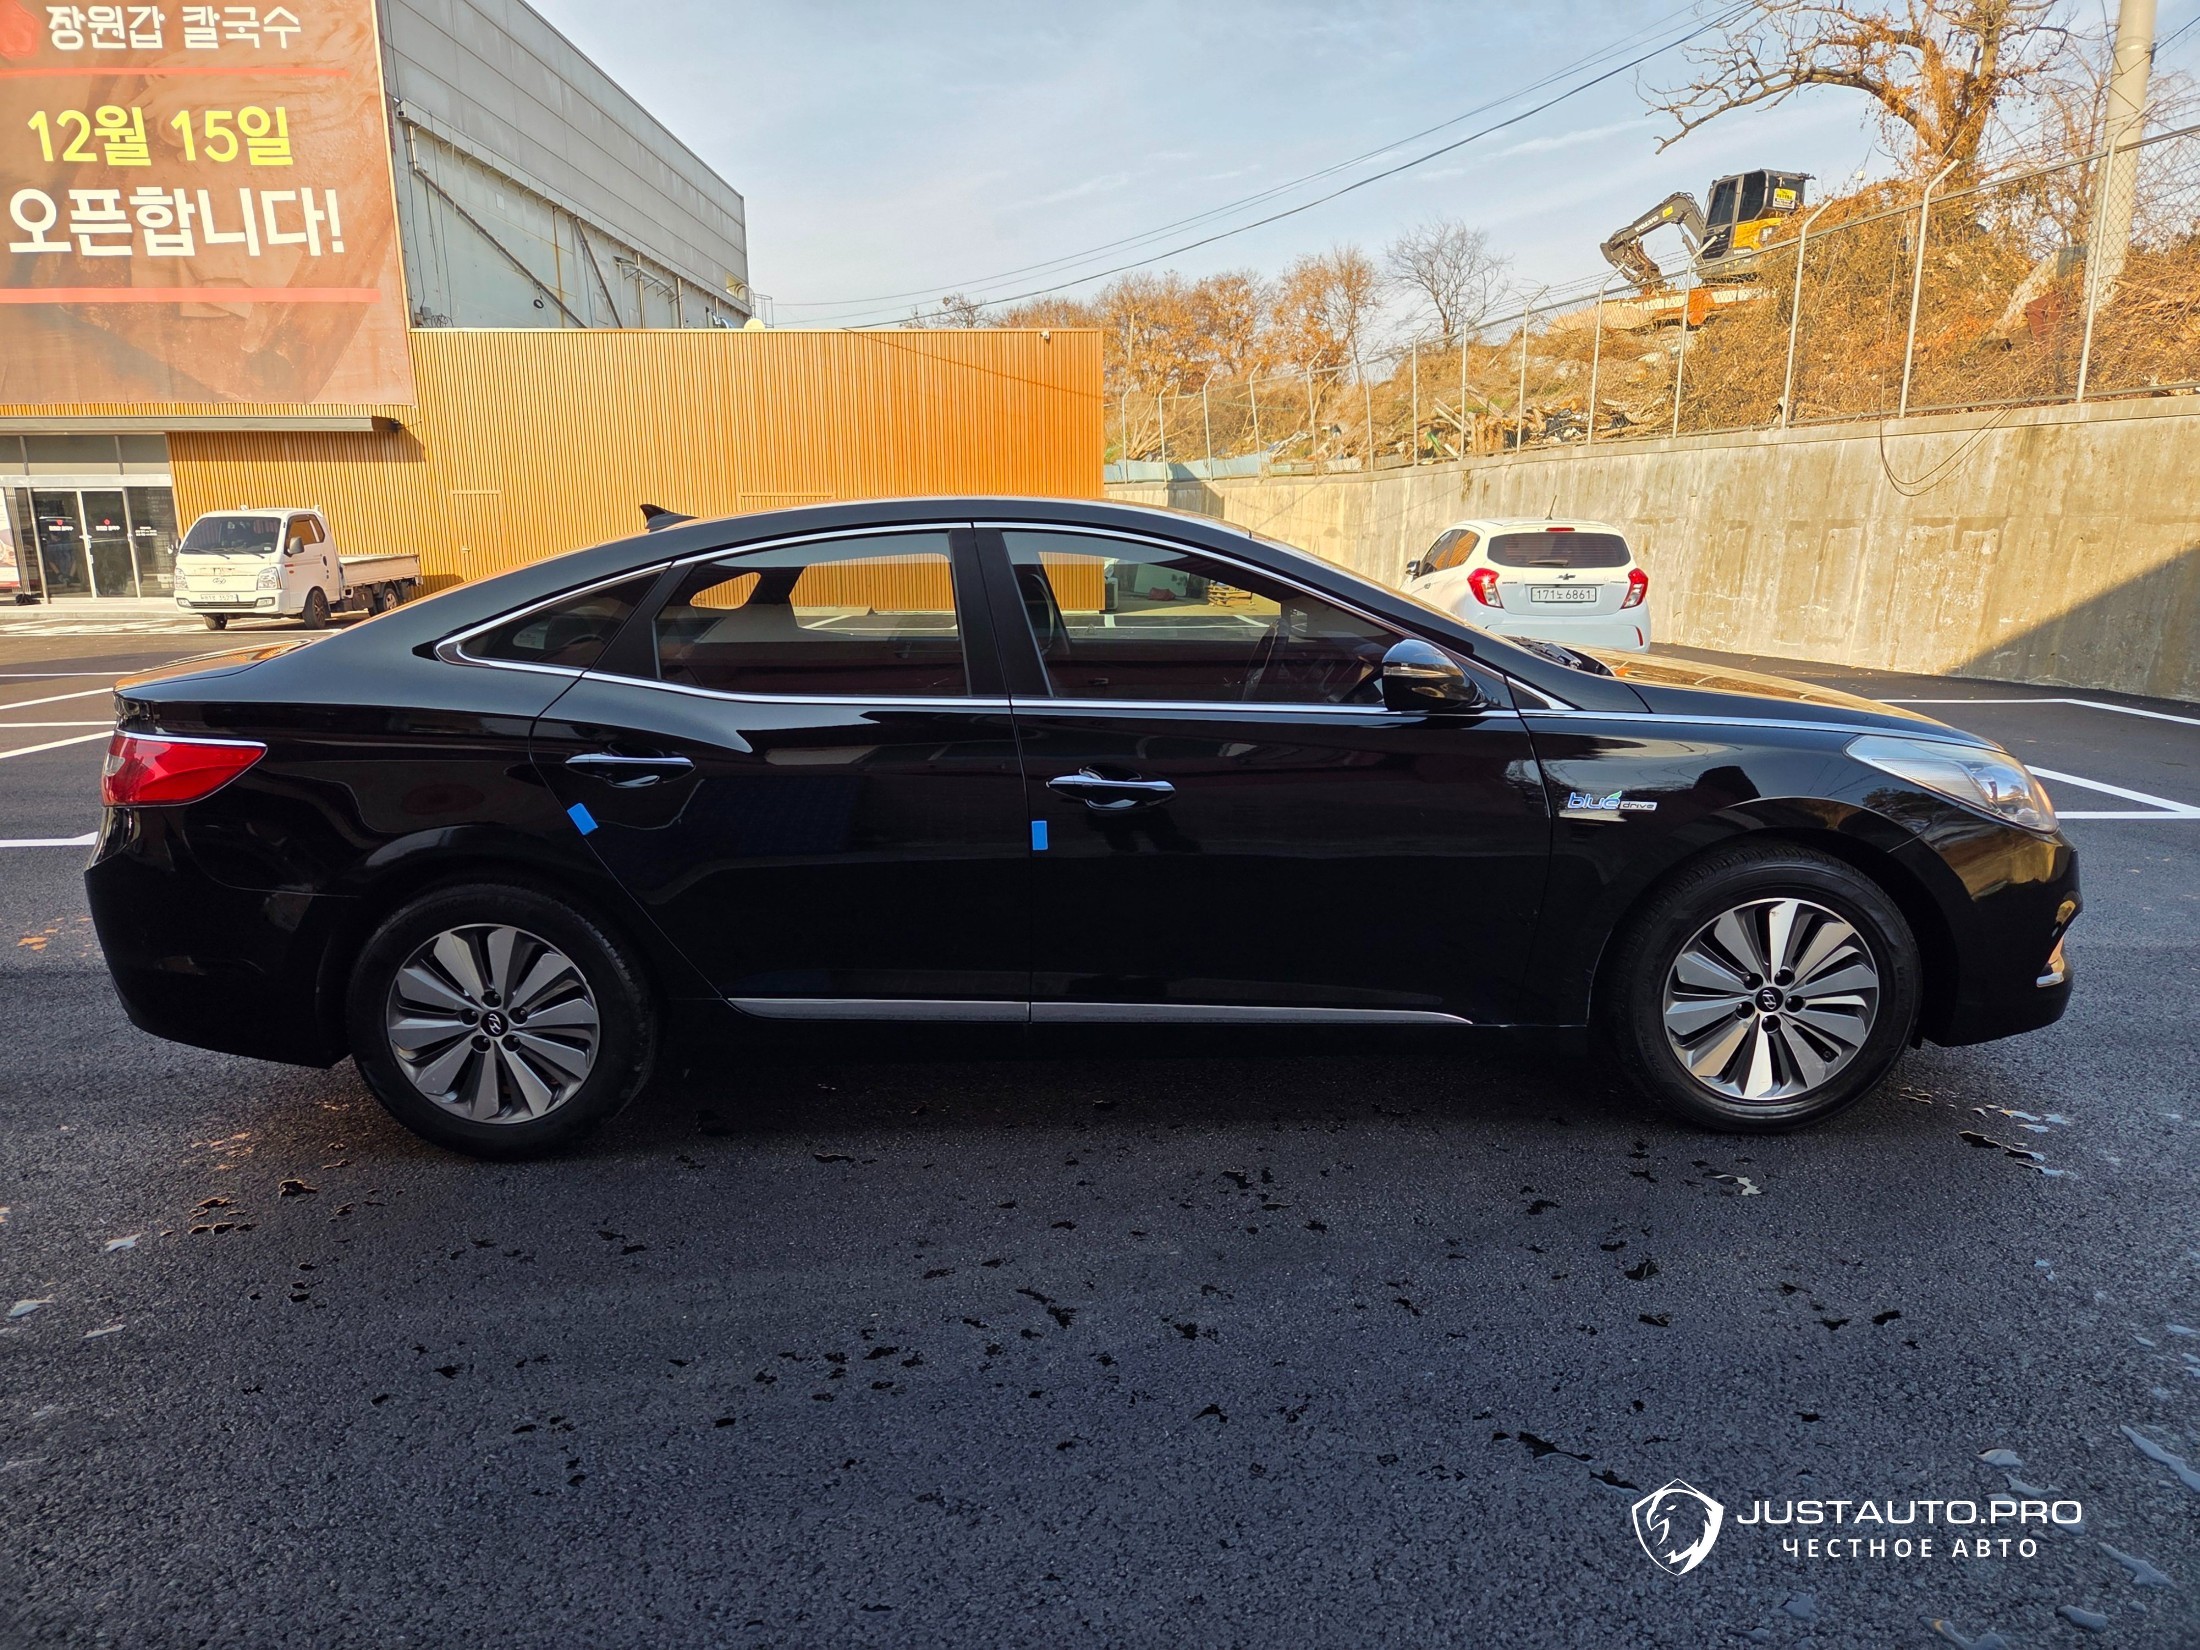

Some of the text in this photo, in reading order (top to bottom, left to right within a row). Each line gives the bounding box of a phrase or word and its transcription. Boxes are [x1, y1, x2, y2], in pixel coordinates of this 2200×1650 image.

[46, 5, 302, 51] 장원갑 칼국수
[27, 105, 294, 166] 12월 15일
[9, 186, 345, 257] 오픈합니다!
[1634, 215, 1659, 232] VOLVO
[1565, 589, 1592, 600] 6861
[1567, 791, 1655, 810] blue drive
